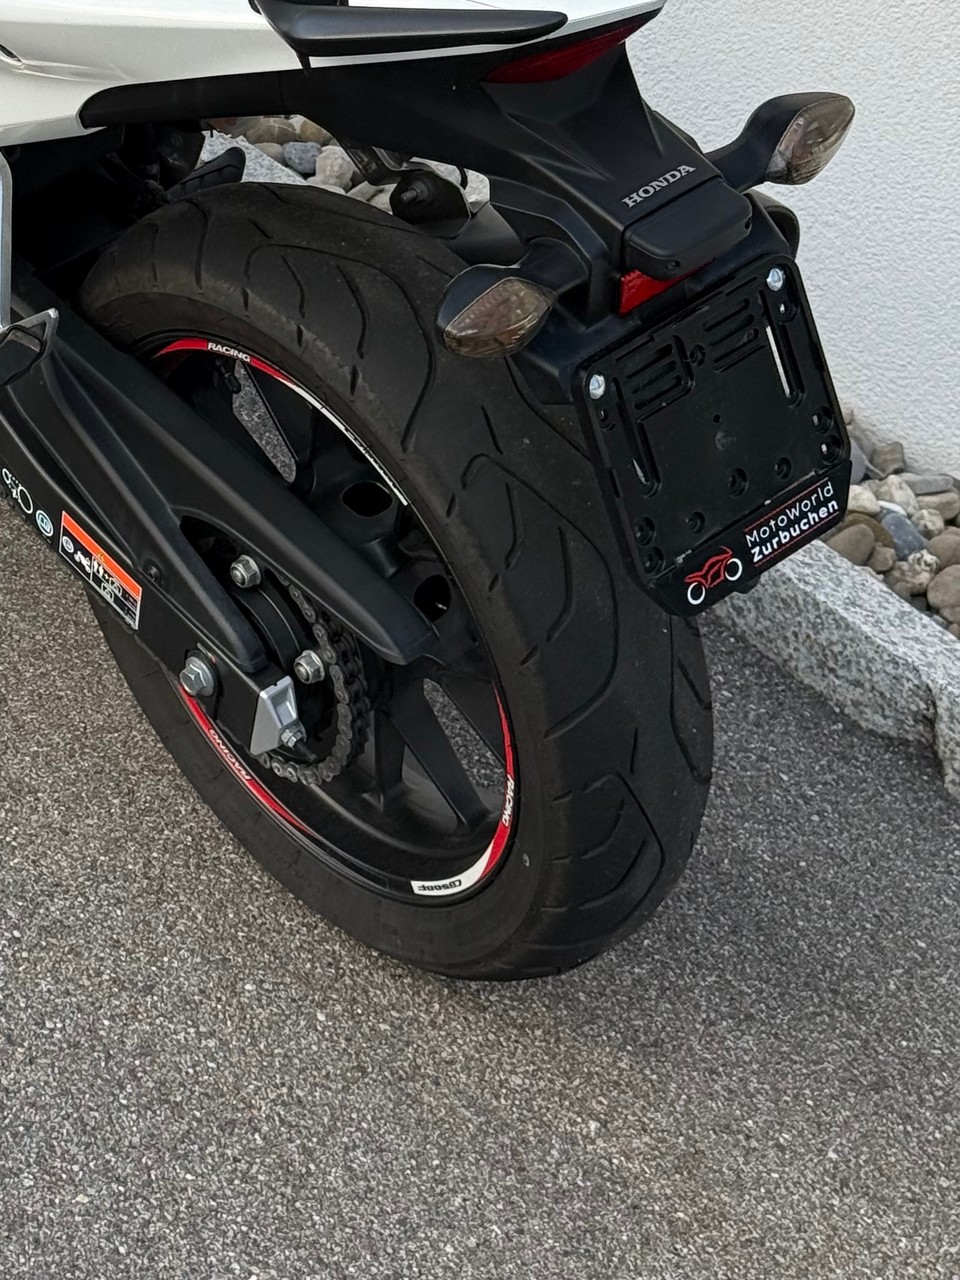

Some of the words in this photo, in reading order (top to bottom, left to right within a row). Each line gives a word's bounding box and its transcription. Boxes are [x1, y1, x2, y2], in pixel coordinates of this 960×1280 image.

[621, 164, 697, 208] HONDA
[207, 342, 251, 363] RACING
[745, 481, 834, 548] MotoWorld
[751, 500, 839, 563] Zurbuchen
[208, 728, 252, 780] RACING
[502, 773, 515, 827] RACING
